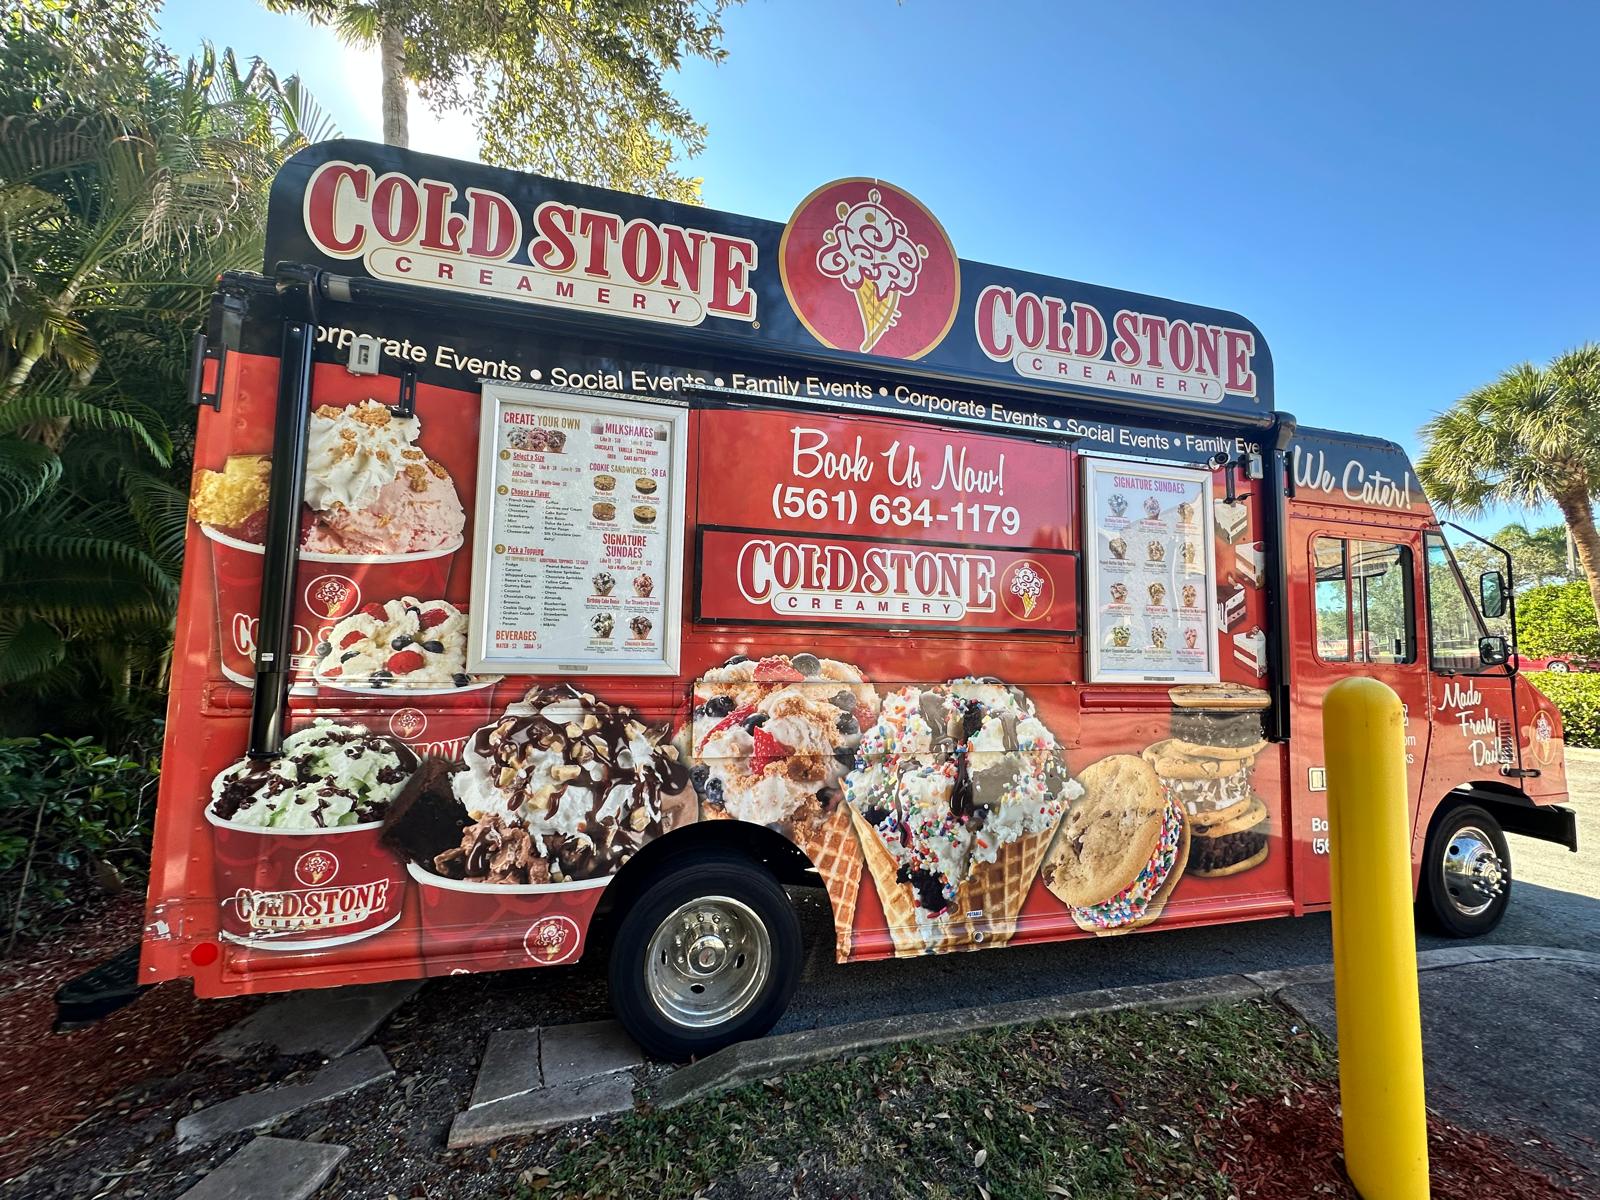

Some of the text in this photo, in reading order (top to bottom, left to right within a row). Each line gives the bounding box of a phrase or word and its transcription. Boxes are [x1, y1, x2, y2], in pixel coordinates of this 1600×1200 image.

[305, 162, 757, 321] COLD STONE
[394, 255, 682, 316] CREAMERY
[976, 286, 1256, 397] COLD STONE
[1032, 357, 1209, 395] CREAMERY
[435, 345, 522, 382] Events
[550, 367, 624, 391] Social
[732, 373, 801, 396] Family
[806, 376, 872, 399] Events
[894, 385, 986, 419] Corporate
[992, 405, 1048, 431] Events
[1066, 419, 1115, 443] Social
[1120, 431, 1169, 450] Events
[1186, 435, 1231, 455] Family
[1235, 438, 1260, 455] Eve
[503, 411, 580, 430] CREATE YOUR OWN
[605, 423, 654, 438] MILKSHAKES
[513, 452, 530, 460] Select
[636, 448, 658, 456] STRAWBERRY
[790, 426, 1006, 497] Book Us Now!
[589, 462, 666, 477] COOKIE SANDWICHES $8 EA
[1293, 445, 1412, 511] We Cater!
[511, 488, 529, 496] Choose
[535, 489, 550, 497] Flavor
[1113, 476, 1185, 494] SIGNATURE SUNDAES
[772, 483, 1021, 536] (561) 634-1179
[602, 533, 647, 547] SIGNATURE
[525, 547, 544, 556] Topping
[606, 546, 643, 558] SUNDAES
[738, 540, 995, 612] COLD STONE
[787, 595, 952, 615] CREAMERY
[496, 630, 537, 641] BEVERAGES
[1437, 680, 1482, 711] Made
[1456, 708, 1496, 737] Fresh
[304, 878, 389, 918] STONE
[258, 912, 361, 927] CREAMERY
